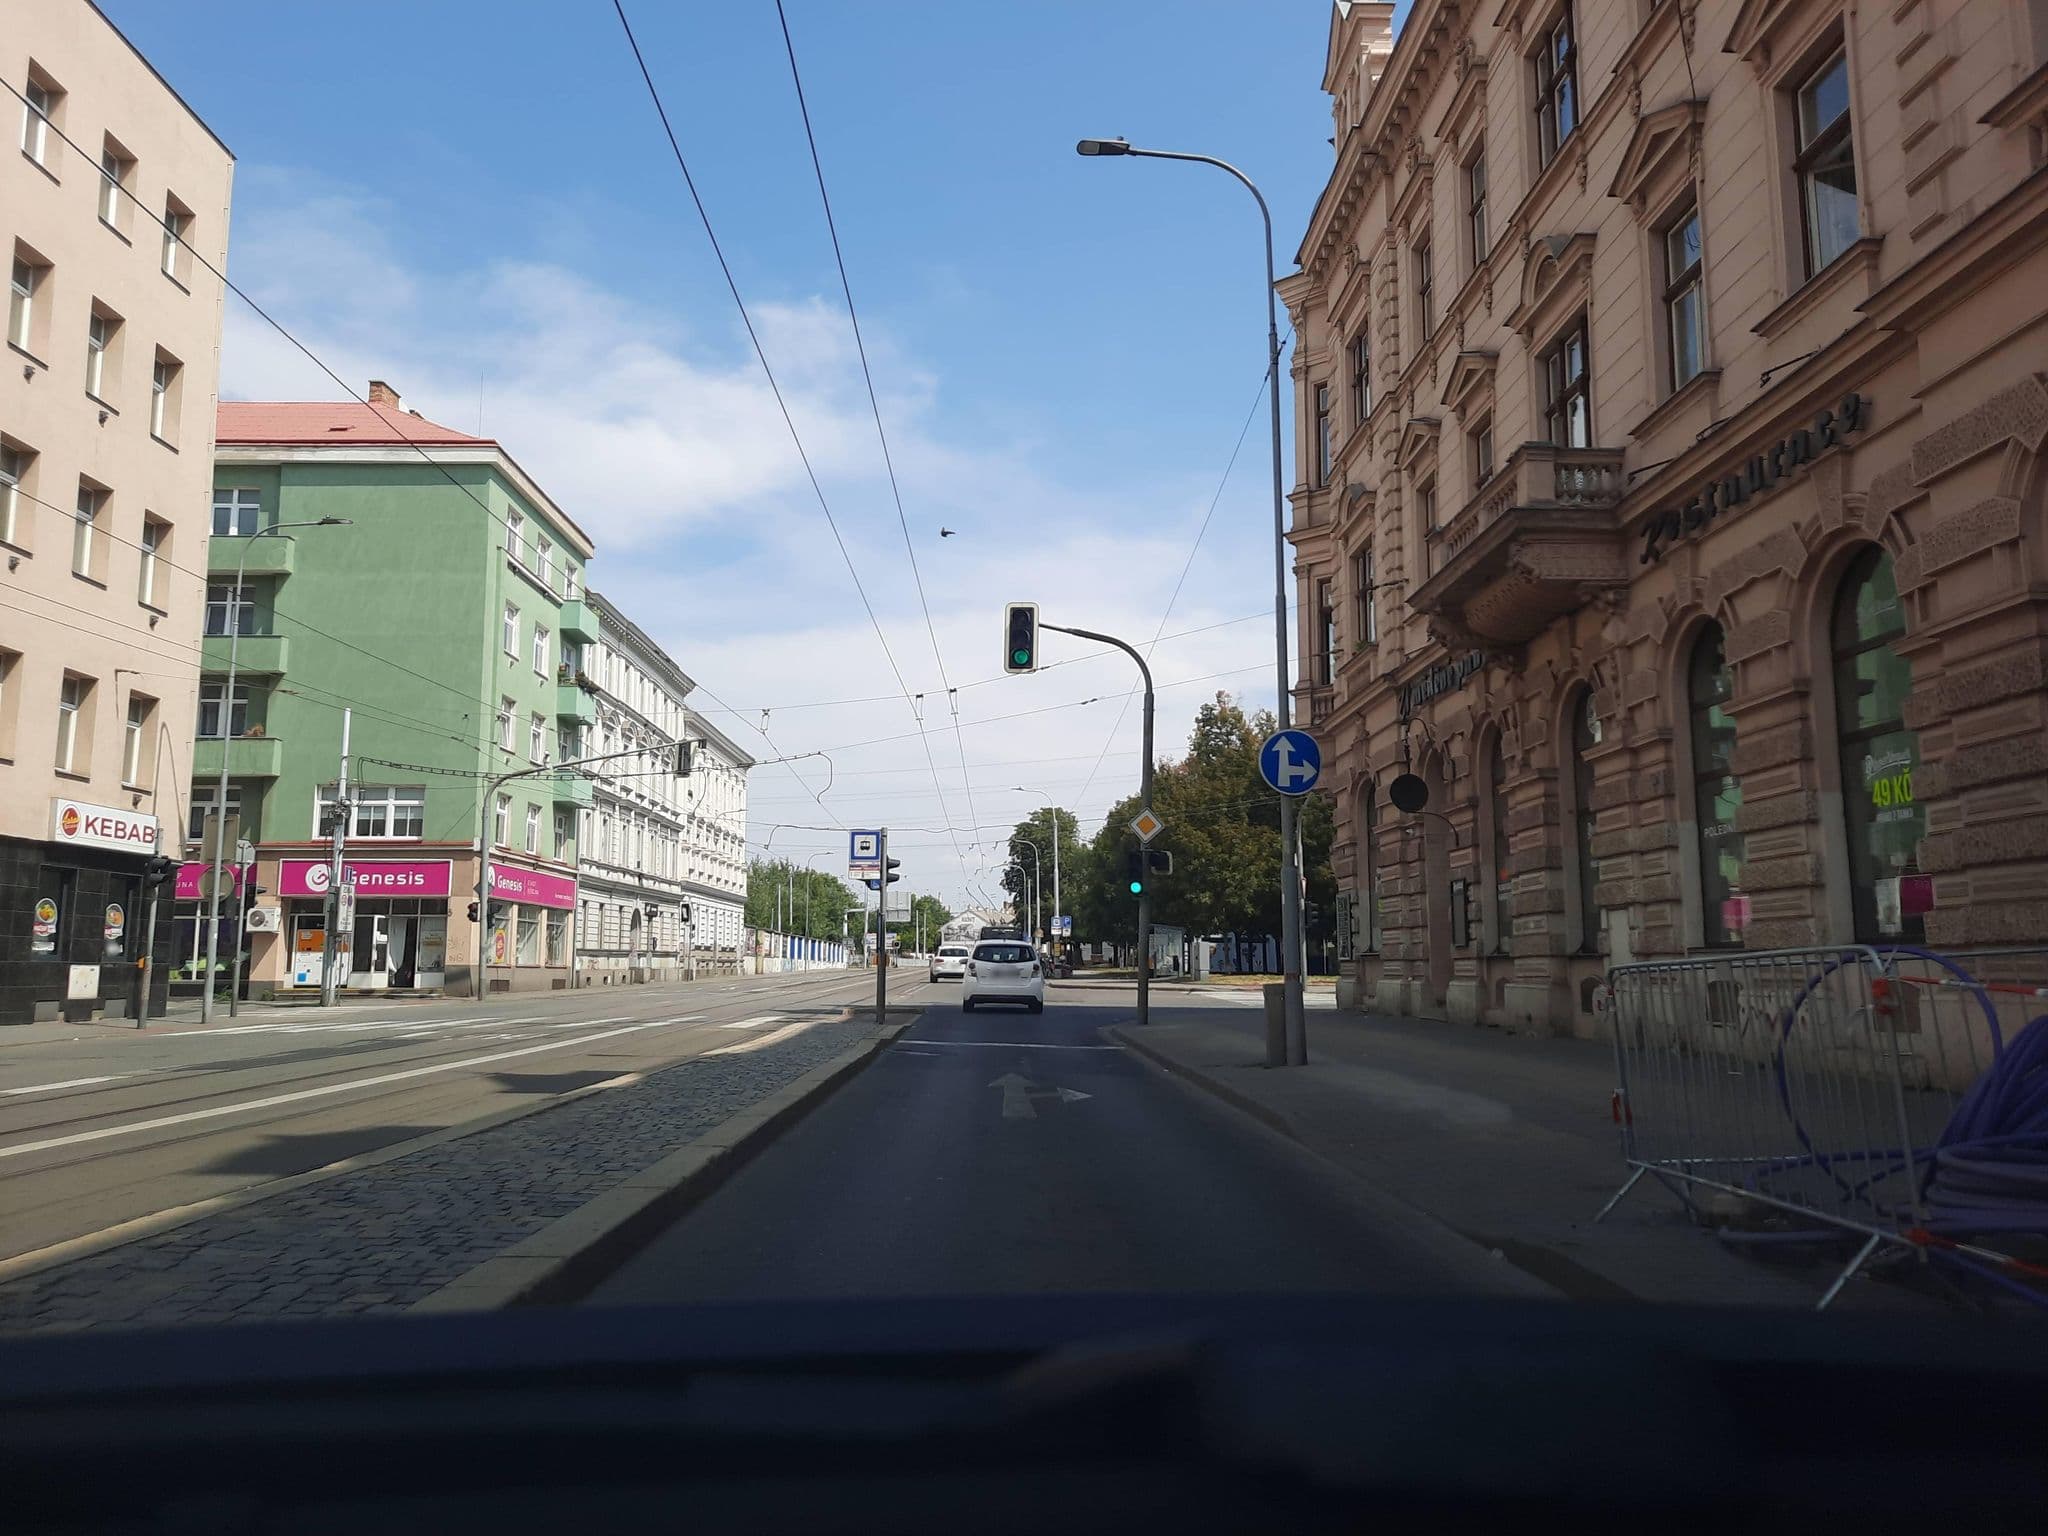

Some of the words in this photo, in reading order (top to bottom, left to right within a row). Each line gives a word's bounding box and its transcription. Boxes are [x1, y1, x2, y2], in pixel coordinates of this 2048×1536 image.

[1872, 778, 1891, 807] 49
[84, 815, 155, 844] KEBAB
[497, 874, 523, 892] Genesis
